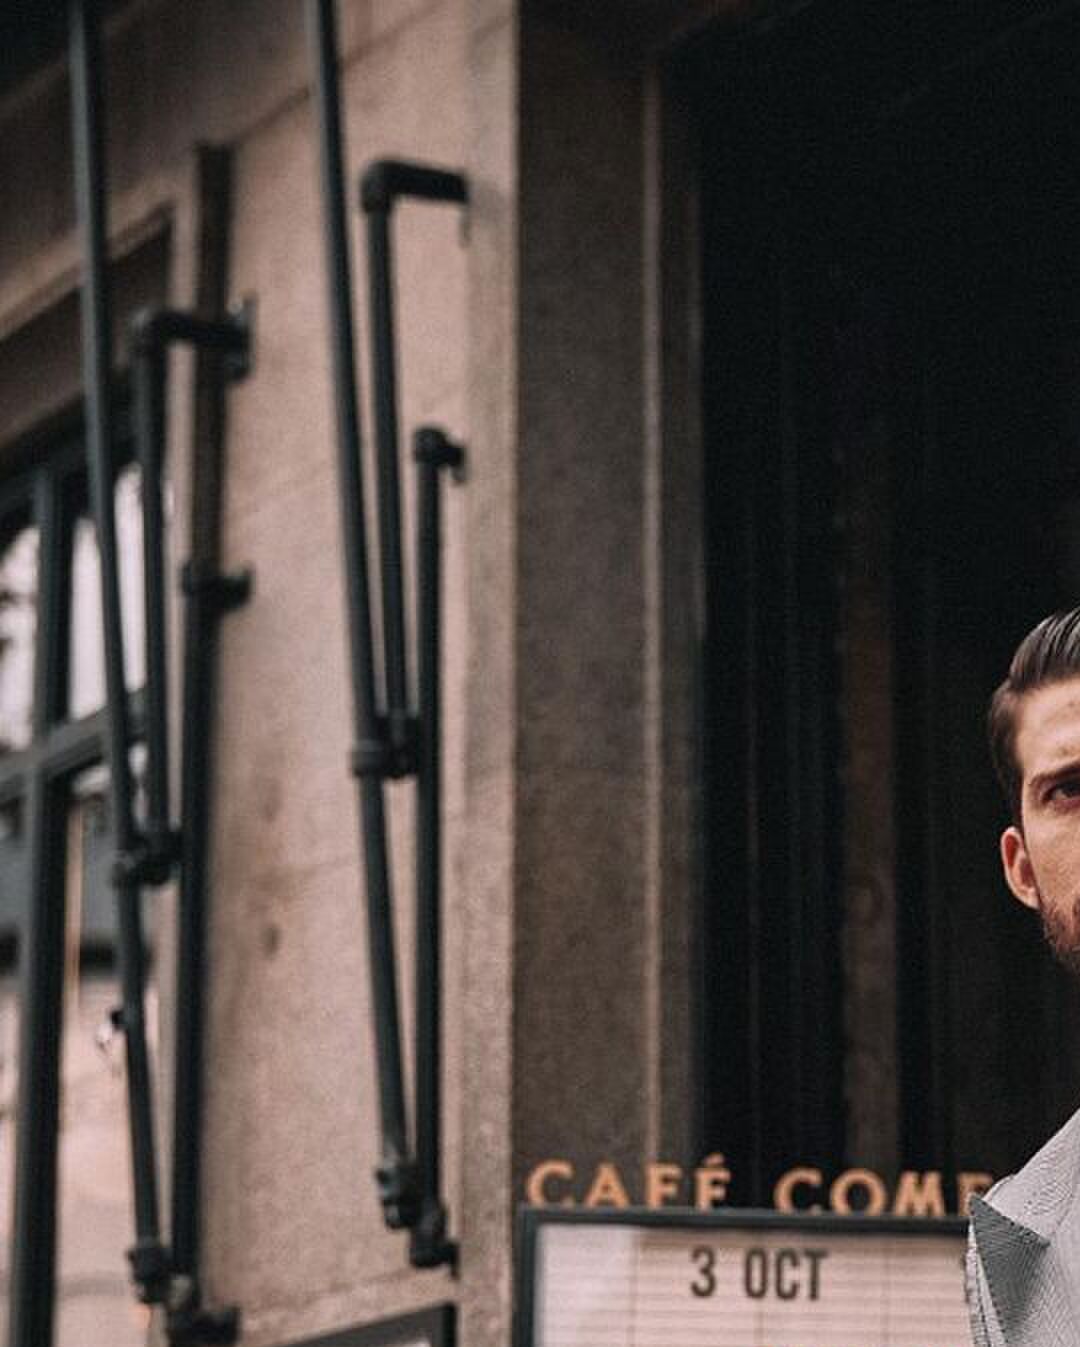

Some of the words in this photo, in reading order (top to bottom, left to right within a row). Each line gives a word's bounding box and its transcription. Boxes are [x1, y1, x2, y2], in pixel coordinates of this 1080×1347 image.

[527, 1152, 731, 1211] CAFÉ
[691, 1245, 716, 1298] 3
[744, 1247, 829, 1301] OCT
